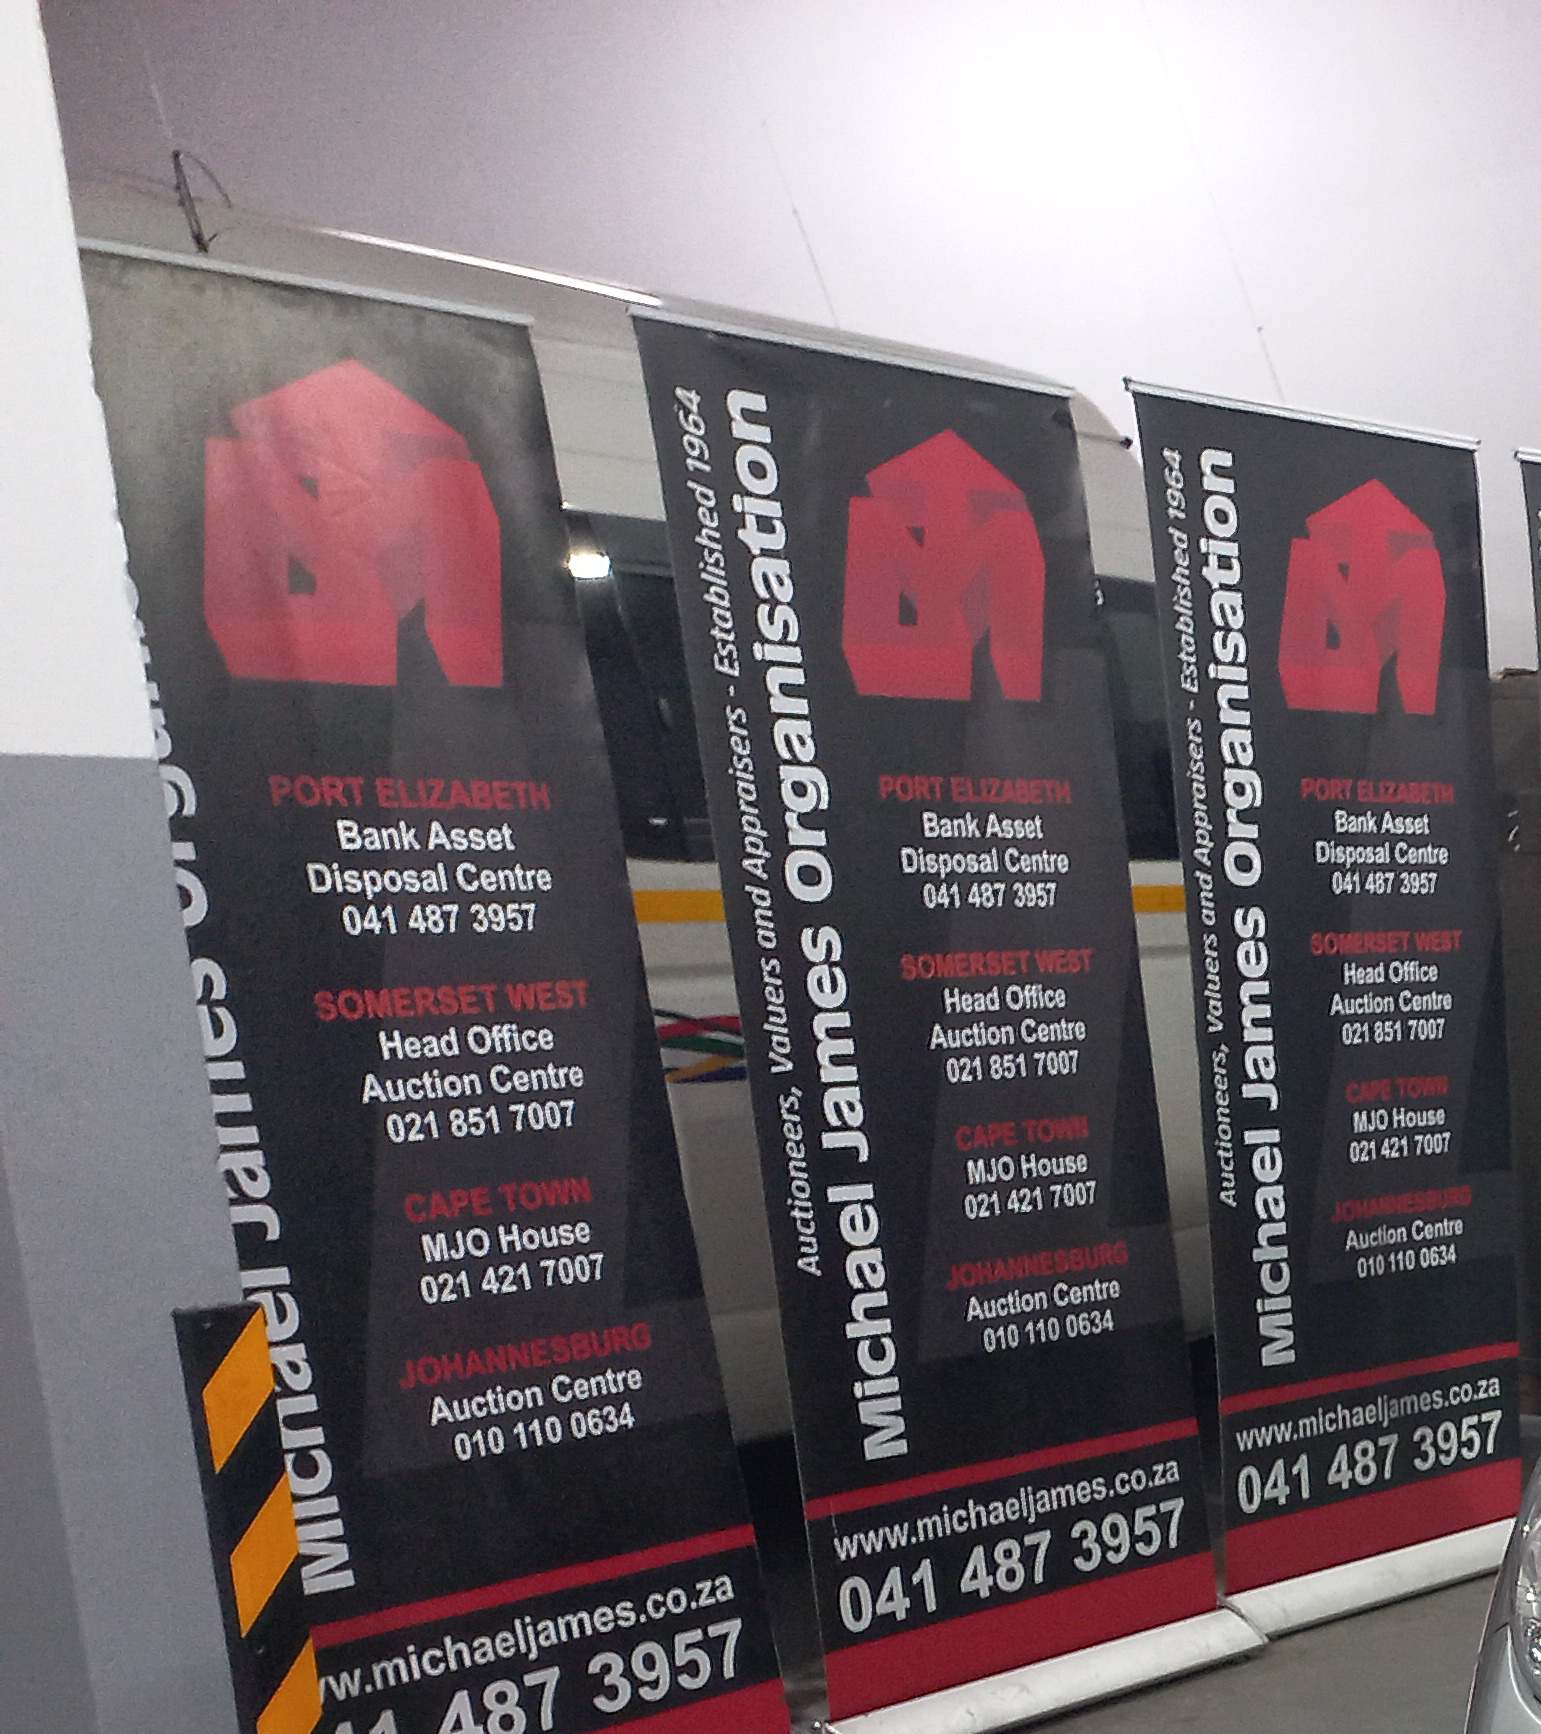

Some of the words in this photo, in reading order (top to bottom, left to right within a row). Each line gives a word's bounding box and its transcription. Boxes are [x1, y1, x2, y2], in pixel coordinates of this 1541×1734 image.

[675, 385, 711, 473] 1964
[1162, 447, 1186, 520] 1964
[686, 480, 740, 677] Established
[1167, 526, 1199, 693] Established
[727, 389, 833, 907] Organisation
[1200, 448, 1263, 891] Organisation
[271, 775, 365, 807] PORT
[375, 777, 550, 810] ELIZABETH
[725, 704, 772, 881] Appraisers
[879, 773, 944, 801] PORT
[949, 775, 1072, 805] ELIZABETH
[1186, 718, 1215, 867] Appraisers
[336, 819, 421, 851] Bank
[428, 820, 516, 851] Asset
[922, 811, 982, 838] Bank
[985, 812, 1044, 840] Asset
[1334, 809, 1378, 834] Bank
[1380, 810, 1430, 835] Asset
[900, 847, 999, 879] Disposal
[1004, 847, 1069, 874] Centre
[1315, 840, 1391, 870] Disposal
[1394, 841, 1449, 865] Centre
[306, 862, 448, 900] Disposal
[455, 862, 552, 892] Centre
[923, 881, 961, 909] 041
[967, 882, 1006, 909] 487
[1012, 881, 1057, 908] 3957
[1195, 871, 1216, 926] and
[1331, 871, 1361, 895] 041
[1364, 871, 1395, 895] 487
[1399, 871, 1438, 895] 3957
[342, 904, 398, 936] 041
[408, 903, 459, 934] 487
[469, 902, 536, 933] 3957
[744, 884, 777, 949] and
[901, 948, 1030, 980] SOMERSET
[1034, 947, 1093, 974] WEST
[1311, 930, 1410, 955] SOMERSET
[1414, 928, 1462, 953] WEST
[1203, 933, 1224, 1033] Valuers
[1343, 961, 1385, 985] Head
[1388, 960, 1438, 984] Office
[314, 983, 497, 1021] SOMERSET
[505, 979, 588, 1010] WEST
[760, 957, 794, 1073] Valuers
[943, 985, 1001, 1014] Head
[1005, 983, 1066, 1011] Office
[1233, 906, 1279, 1111] James
[1330, 991, 1395, 1016] Auction
[1398, 989, 1453, 1013] Centre
[378, 1026, 460, 1061] Head
[467, 1023, 554, 1055] Office
[800, 925, 869, 1163] James
[930, 1021, 1015, 1050] Auction
[1020, 1018, 1086, 1044] Centre
[1342, 1021, 1370, 1045] 021
[1374, 1019, 1402, 1044] 851
[1407, 1017, 1445, 1041] 7007
[362, 1068, 483, 1104] Auction
[489, 1062, 584, 1094] Centre
[946, 1055, 983, 1084] 021
[989, 1052, 1027, 1080] 851
[1033, 1049, 1079, 1076] 7007
[386, 1110, 439, 1143] 021
[449, 1105, 500, 1138] 851
[508, 1099, 575, 1132] 7007
[955, 1119, 1019, 1151] CAPE
[1024, 1115, 1089, 1143] TOWN
[1212, 1043, 1238, 1208] Auctioneers,
[1352, 1108, 1389, 1134] MJO
[1392, 1107, 1446, 1129] House
[966, 1155, 1015, 1185] MJO
[1020, 1153, 1088, 1179] House
[1349, 1138, 1377, 1164] 021
[1380, 1135, 1408, 1159] 421
[1413, 1131, 1451, 1156] 7007
[404, 1185, 493, 1223] CAPE
[500, 1177, 593, 1212] TOWN
[779, 1086, 822, 1277] Auctioneers,
[964, 1190, 1001, 1220] 021
[1007, 1186, 1043, 1214] 421
[1049, 1180, 1097, 1209] 7007
[421, 1227, 490, 1263] MJO
[498, 1222, 591, 1254] House
[1243, 1128, 1296, 1367] Michael
[1345, 1224, 1408, 1251] Auction
[1411, 1217, 1463, 1241] Centre
[420, 1270, 471, 1305] 021
[481, 1262, 532, 1295] 421
[539, 1251, 604, 1287] 7007
[1357, 1253, 1385, 1278] 010
[1388, 1249, 1416, 1272] 110
[1419, 1243, 1457, 1269] 0634
[826, 1183, 908, 1461] Michael
[967, 1289, 1048, 1322] Auction
[1053, 1278, 1121, 1307] Centre
[983, 1323, 1020, 1353] 010
[1024, 1316, 1060, 1345] 110
[1065, 1308, 1114, 1338] 0634
[399, 1321, 652, 1389] JOHANNESBURG
[430, 1385, 544, 1428] Auction
[551, 1368, 642, 1403] Centre
[1235, 1377, 1503, 1452] www.michaeljames.co.za
[454, 1426, 505, 1461] 010
[513, 1415, 563, 1449] 110
[570, 1401, 636, 1439] 0634
[1237, 1453, 1310, 1514] 041
[1327, 1433, 1399, 1490] 487
[1413, 1409, 1502, 1471] 3957
[833, 1460, 1180, 1562] www.michaeljames.co.za
[839, 1558, 937, 1633] 041
[960, 1529, 1052, 1599] 487
[1070, 1496, 1185, 1572] 3957
[320, 1573, 733, 1703] w.michaeljames.co.za
[592, 1619, 742, 1713] 3957
